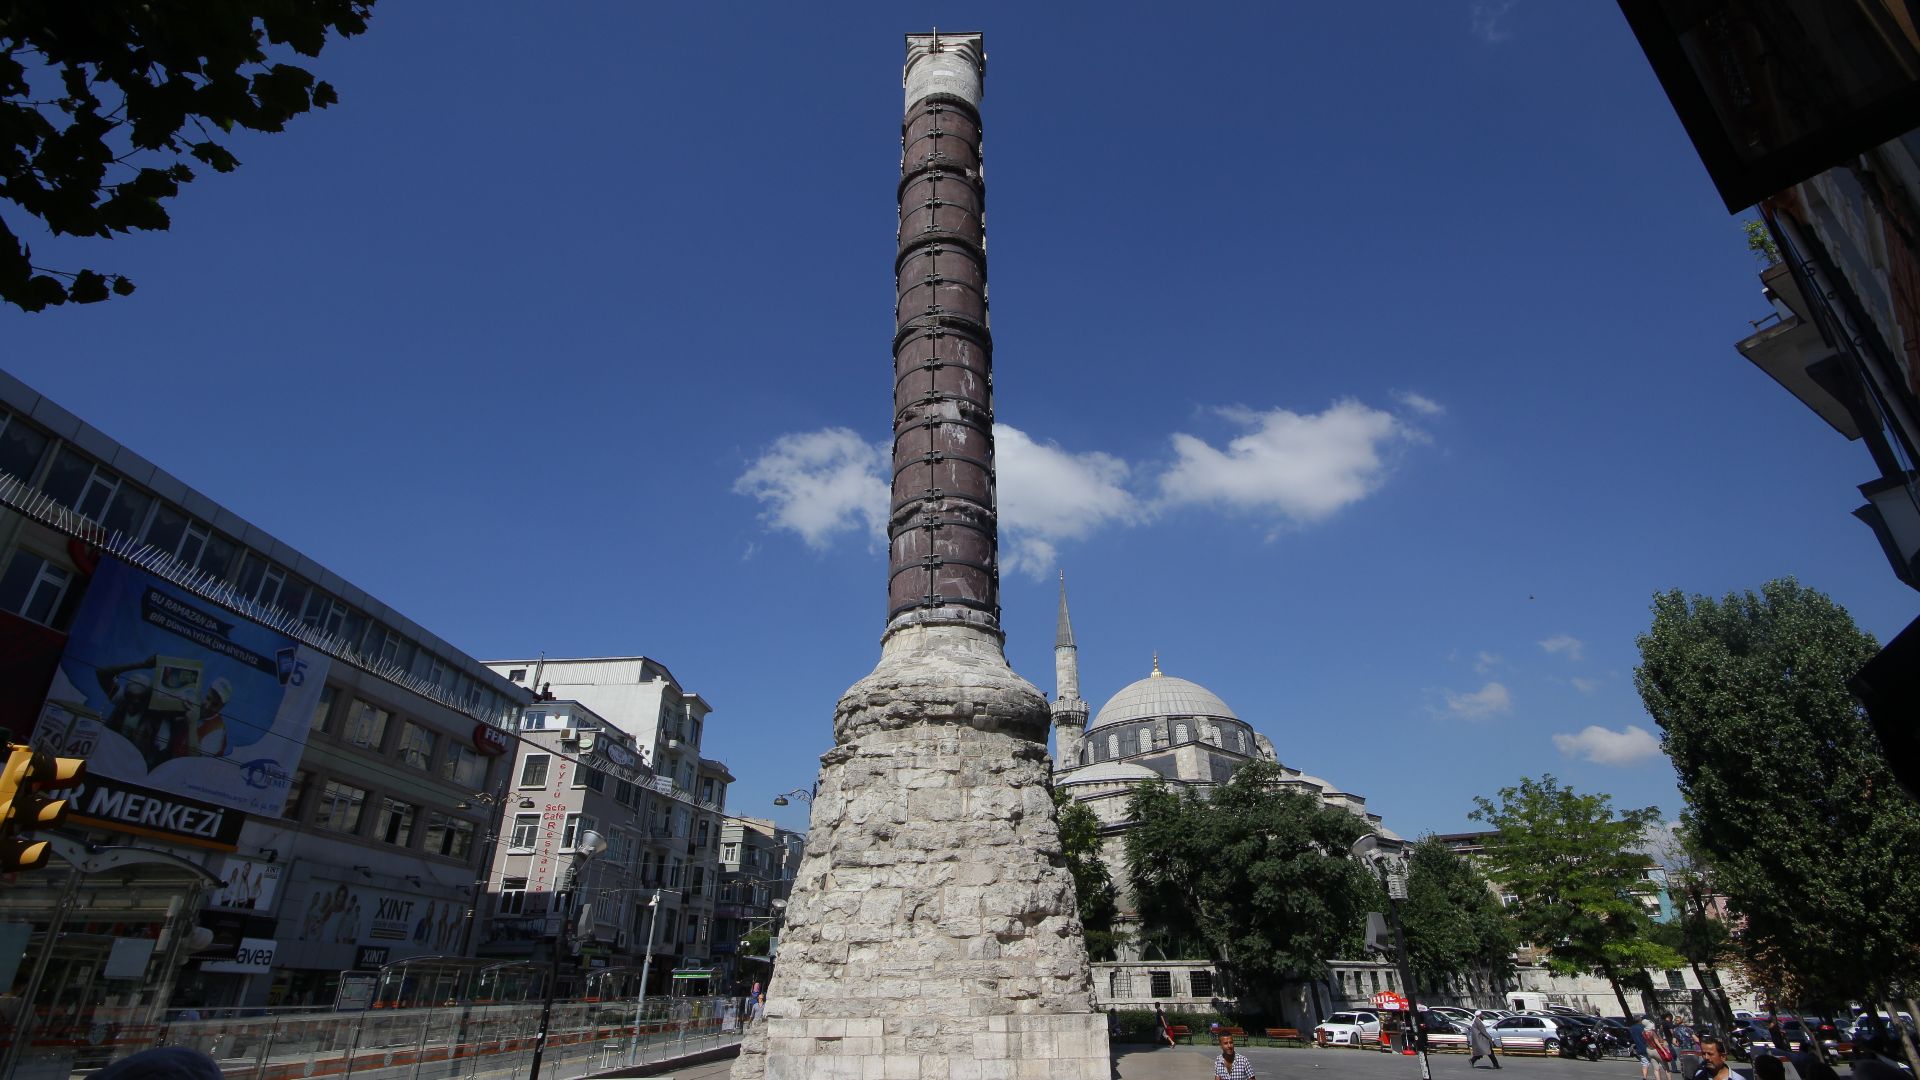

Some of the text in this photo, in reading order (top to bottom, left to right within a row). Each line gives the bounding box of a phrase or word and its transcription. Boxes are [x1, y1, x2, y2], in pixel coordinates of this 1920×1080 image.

[149, 611, 166, 625] BİR
[150, 591, 165, 605] BU
[164, 599, 206, 626] RAMAZAN
[291, 662, 308, 687] 5
[484, 727, 507, 747] FEM
[66, 740, 92, 756] 40
[86, 786, 225, 839] MERKEZİ
[543, 812, 565, 821] Cafe
[375, 897, 415, 922] XINT
[237, 947, 273, 966] avea
[362, 948, 387, 963] XINT
